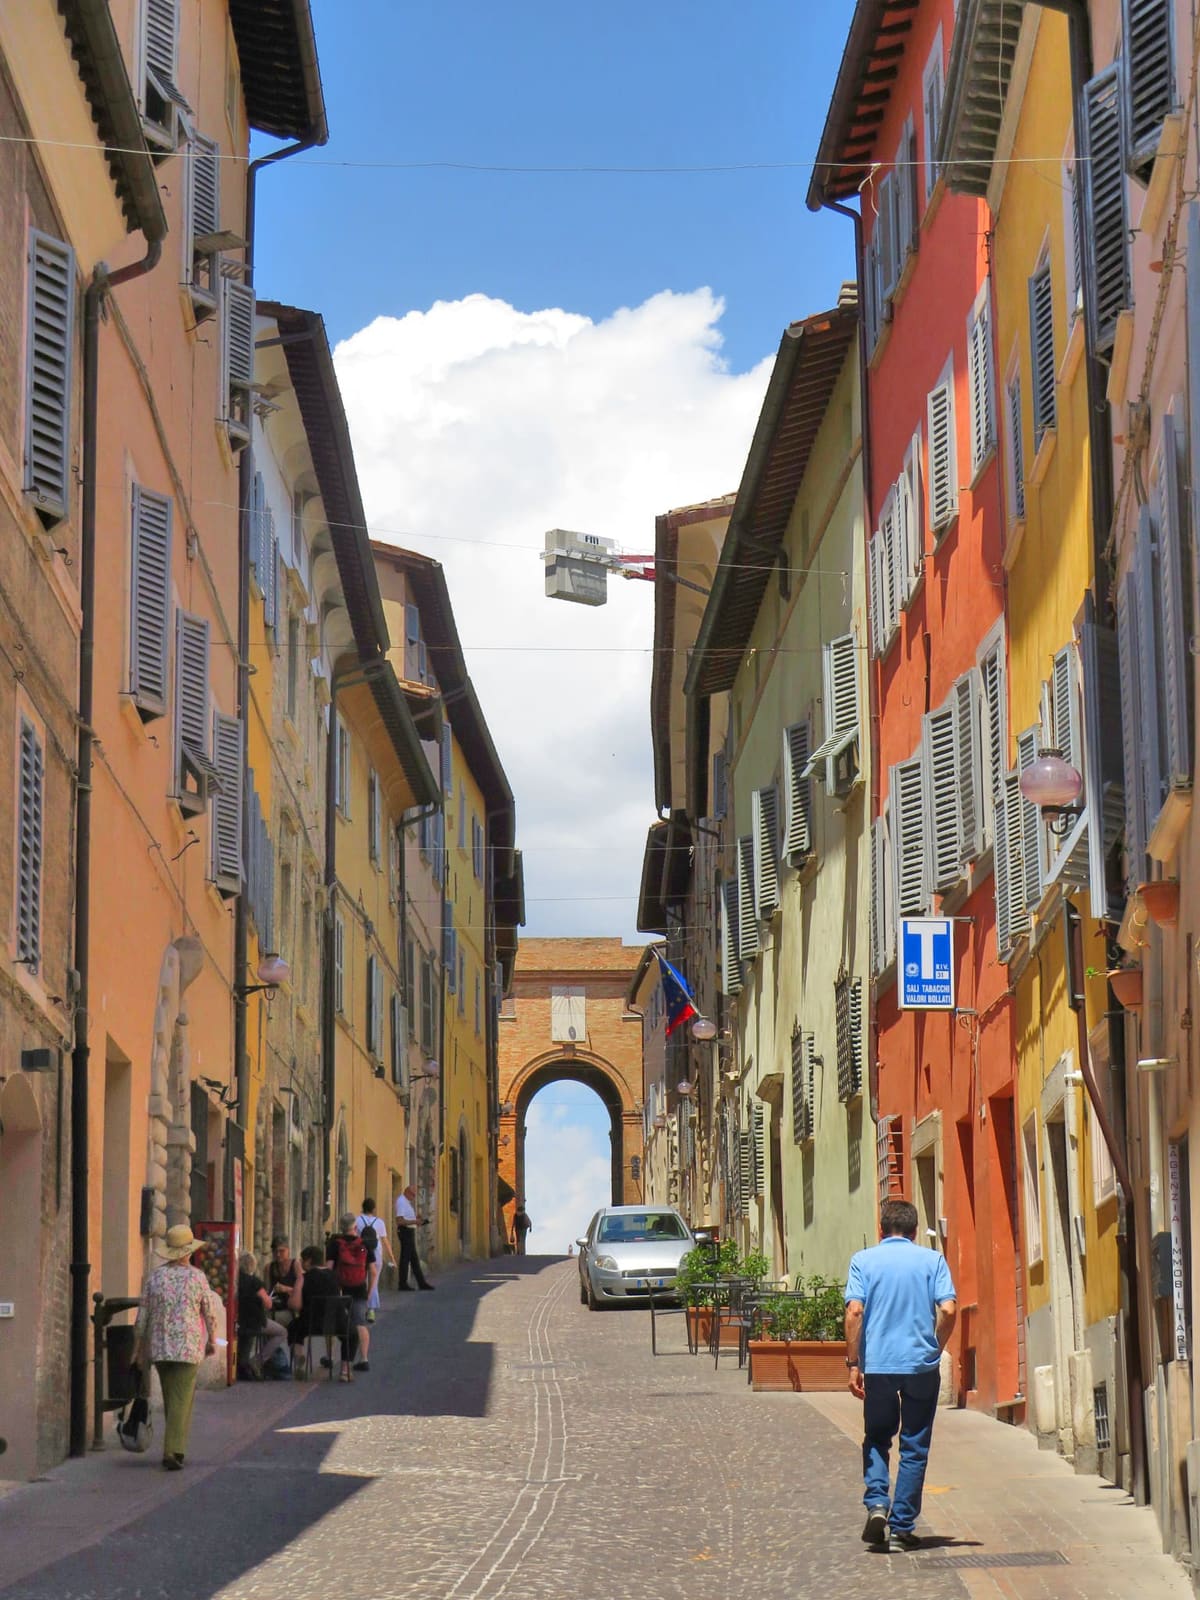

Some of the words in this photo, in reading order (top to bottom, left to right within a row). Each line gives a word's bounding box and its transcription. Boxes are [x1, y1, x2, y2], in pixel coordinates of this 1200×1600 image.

[907, 922, 947, 979] T
[906, 984, 919, 993] SALI
[922, 984, 950, 993] TABACCHI
[906, 994, 927, 1003] VALORI
[928, 994, 951, 1003] BOLLATI
[1170, 1150, 1180, 1222] AGENZIA
[1172, 1236, 1186, 1354] IMMOBILIARE
